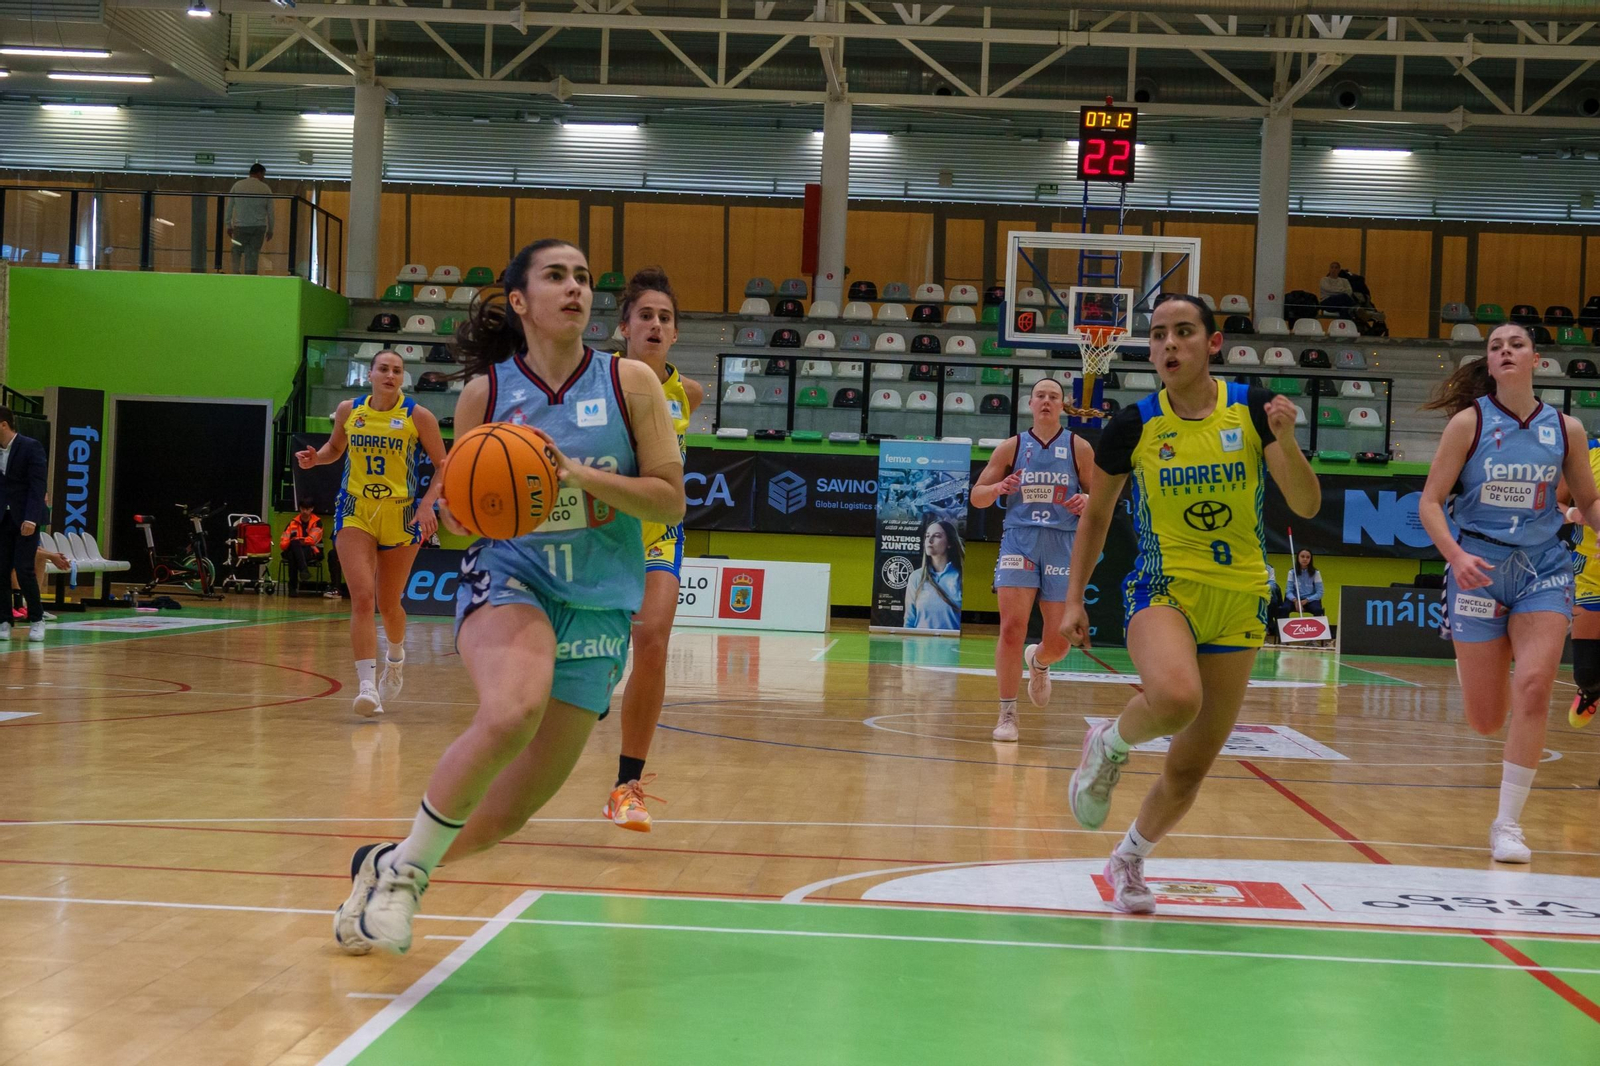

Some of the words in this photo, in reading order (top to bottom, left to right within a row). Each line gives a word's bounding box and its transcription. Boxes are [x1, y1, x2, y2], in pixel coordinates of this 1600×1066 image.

[1085, 111, 1132, 128] 07:12
[1083, 139, 1131, 175] 22
[350, 434, 403, 451] ADAREVA
[365, 455, 386, 476] 13
[884, 453, 912, 464] femxa
[1020, 467, 1069, 485] femxa
[1159, 461, 1247, 487] ADAREVA
[1483, 457, 1558, 482] femxa
[816, 477, 878, 495] SAVINO
[1023, 487, 1052, 495] CONCELLO
[1160, 481, 1247, 496] TENERIFE
[1485, 484, 1532, 495] CONCELLO
[815, 500, 839, 509] Global
[840, 501, 873, 511] Logistics
[1489, 493, 1501, 501] DE
[1503, 494, 1526, 503] VIGO
[1031, 510, 1051, 524] 52
[1510, 515, 1519, 534] 1
[880, 542, 921, 551] XUNTOS
[881, 535, 921, 543] VOLTEMOS
[1210, 540, 1233, 566] 8
[543, 543, 573, 583] 11
[1366, 592, 1444, 628] máis
[1457, 597, 1493, 608] CONCELLO
[1469, 605, 1488, 614] VIGO
[557, 634, 625, 659] ecalvi
